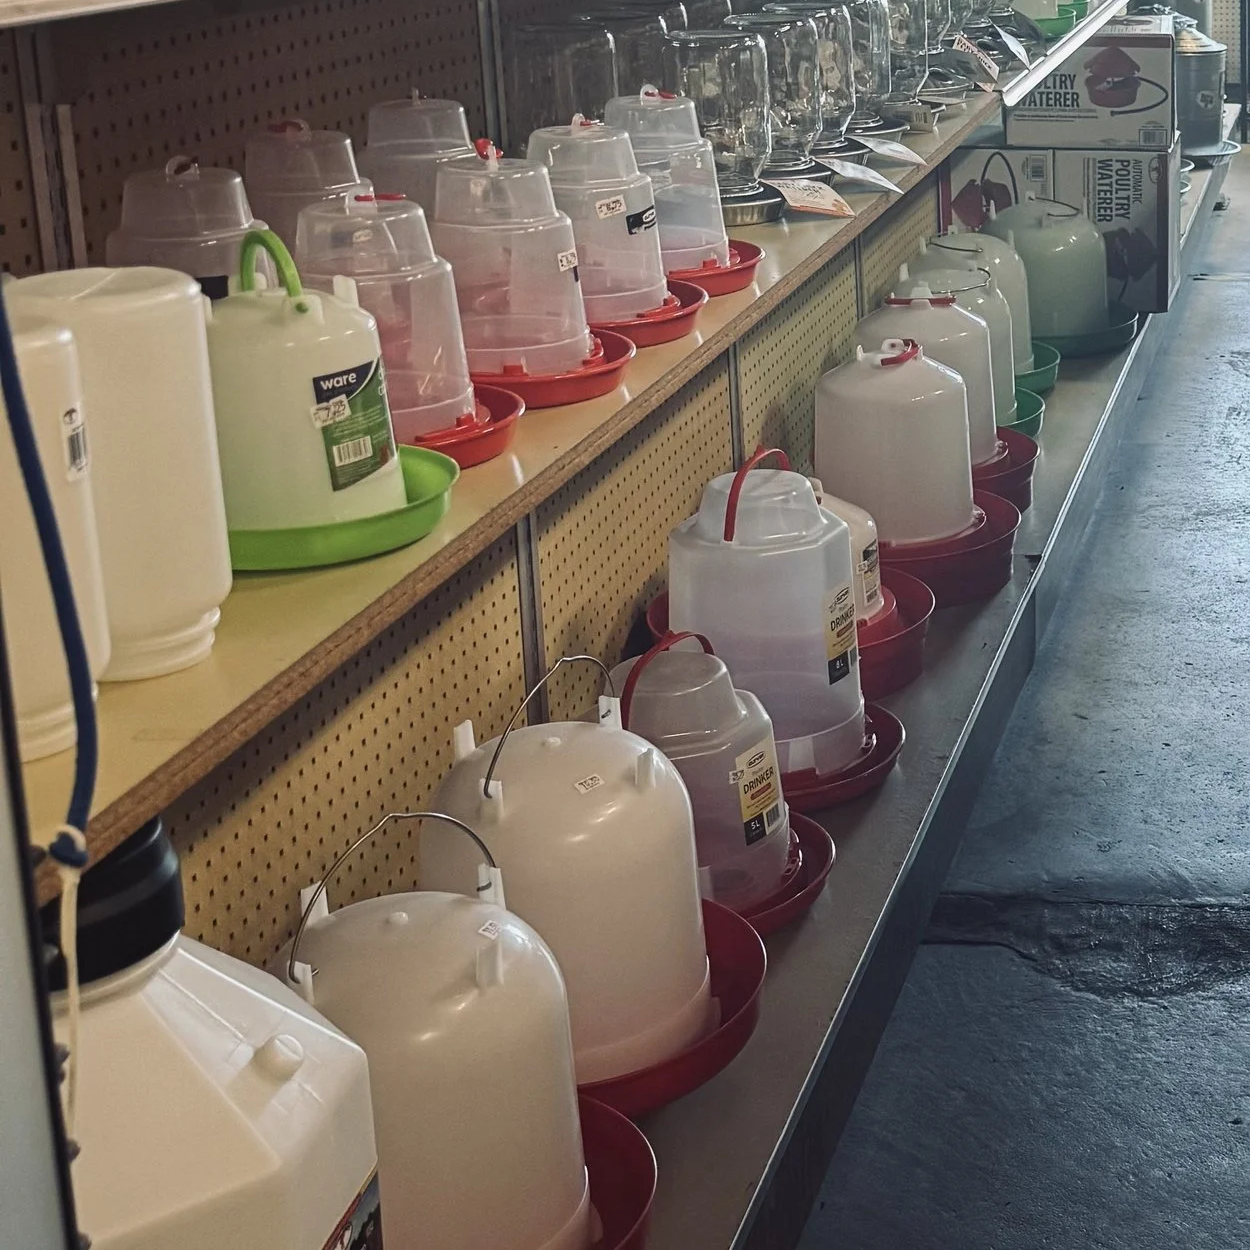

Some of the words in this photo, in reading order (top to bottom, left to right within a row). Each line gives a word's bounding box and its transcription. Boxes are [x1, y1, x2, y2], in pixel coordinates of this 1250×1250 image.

[1041, 73, 1077, 90] LTRY
[1018, 91, 1080, 108] WATERER
[1097, 158, 1114, 223] WATERER
[1115, 159, 1131, 220] POULTRY
[1132, 158, 1143, 204] AUTOMATIC
[320, 372, 357, 391] ware
[743, 766, 775, 795] DRINKER
